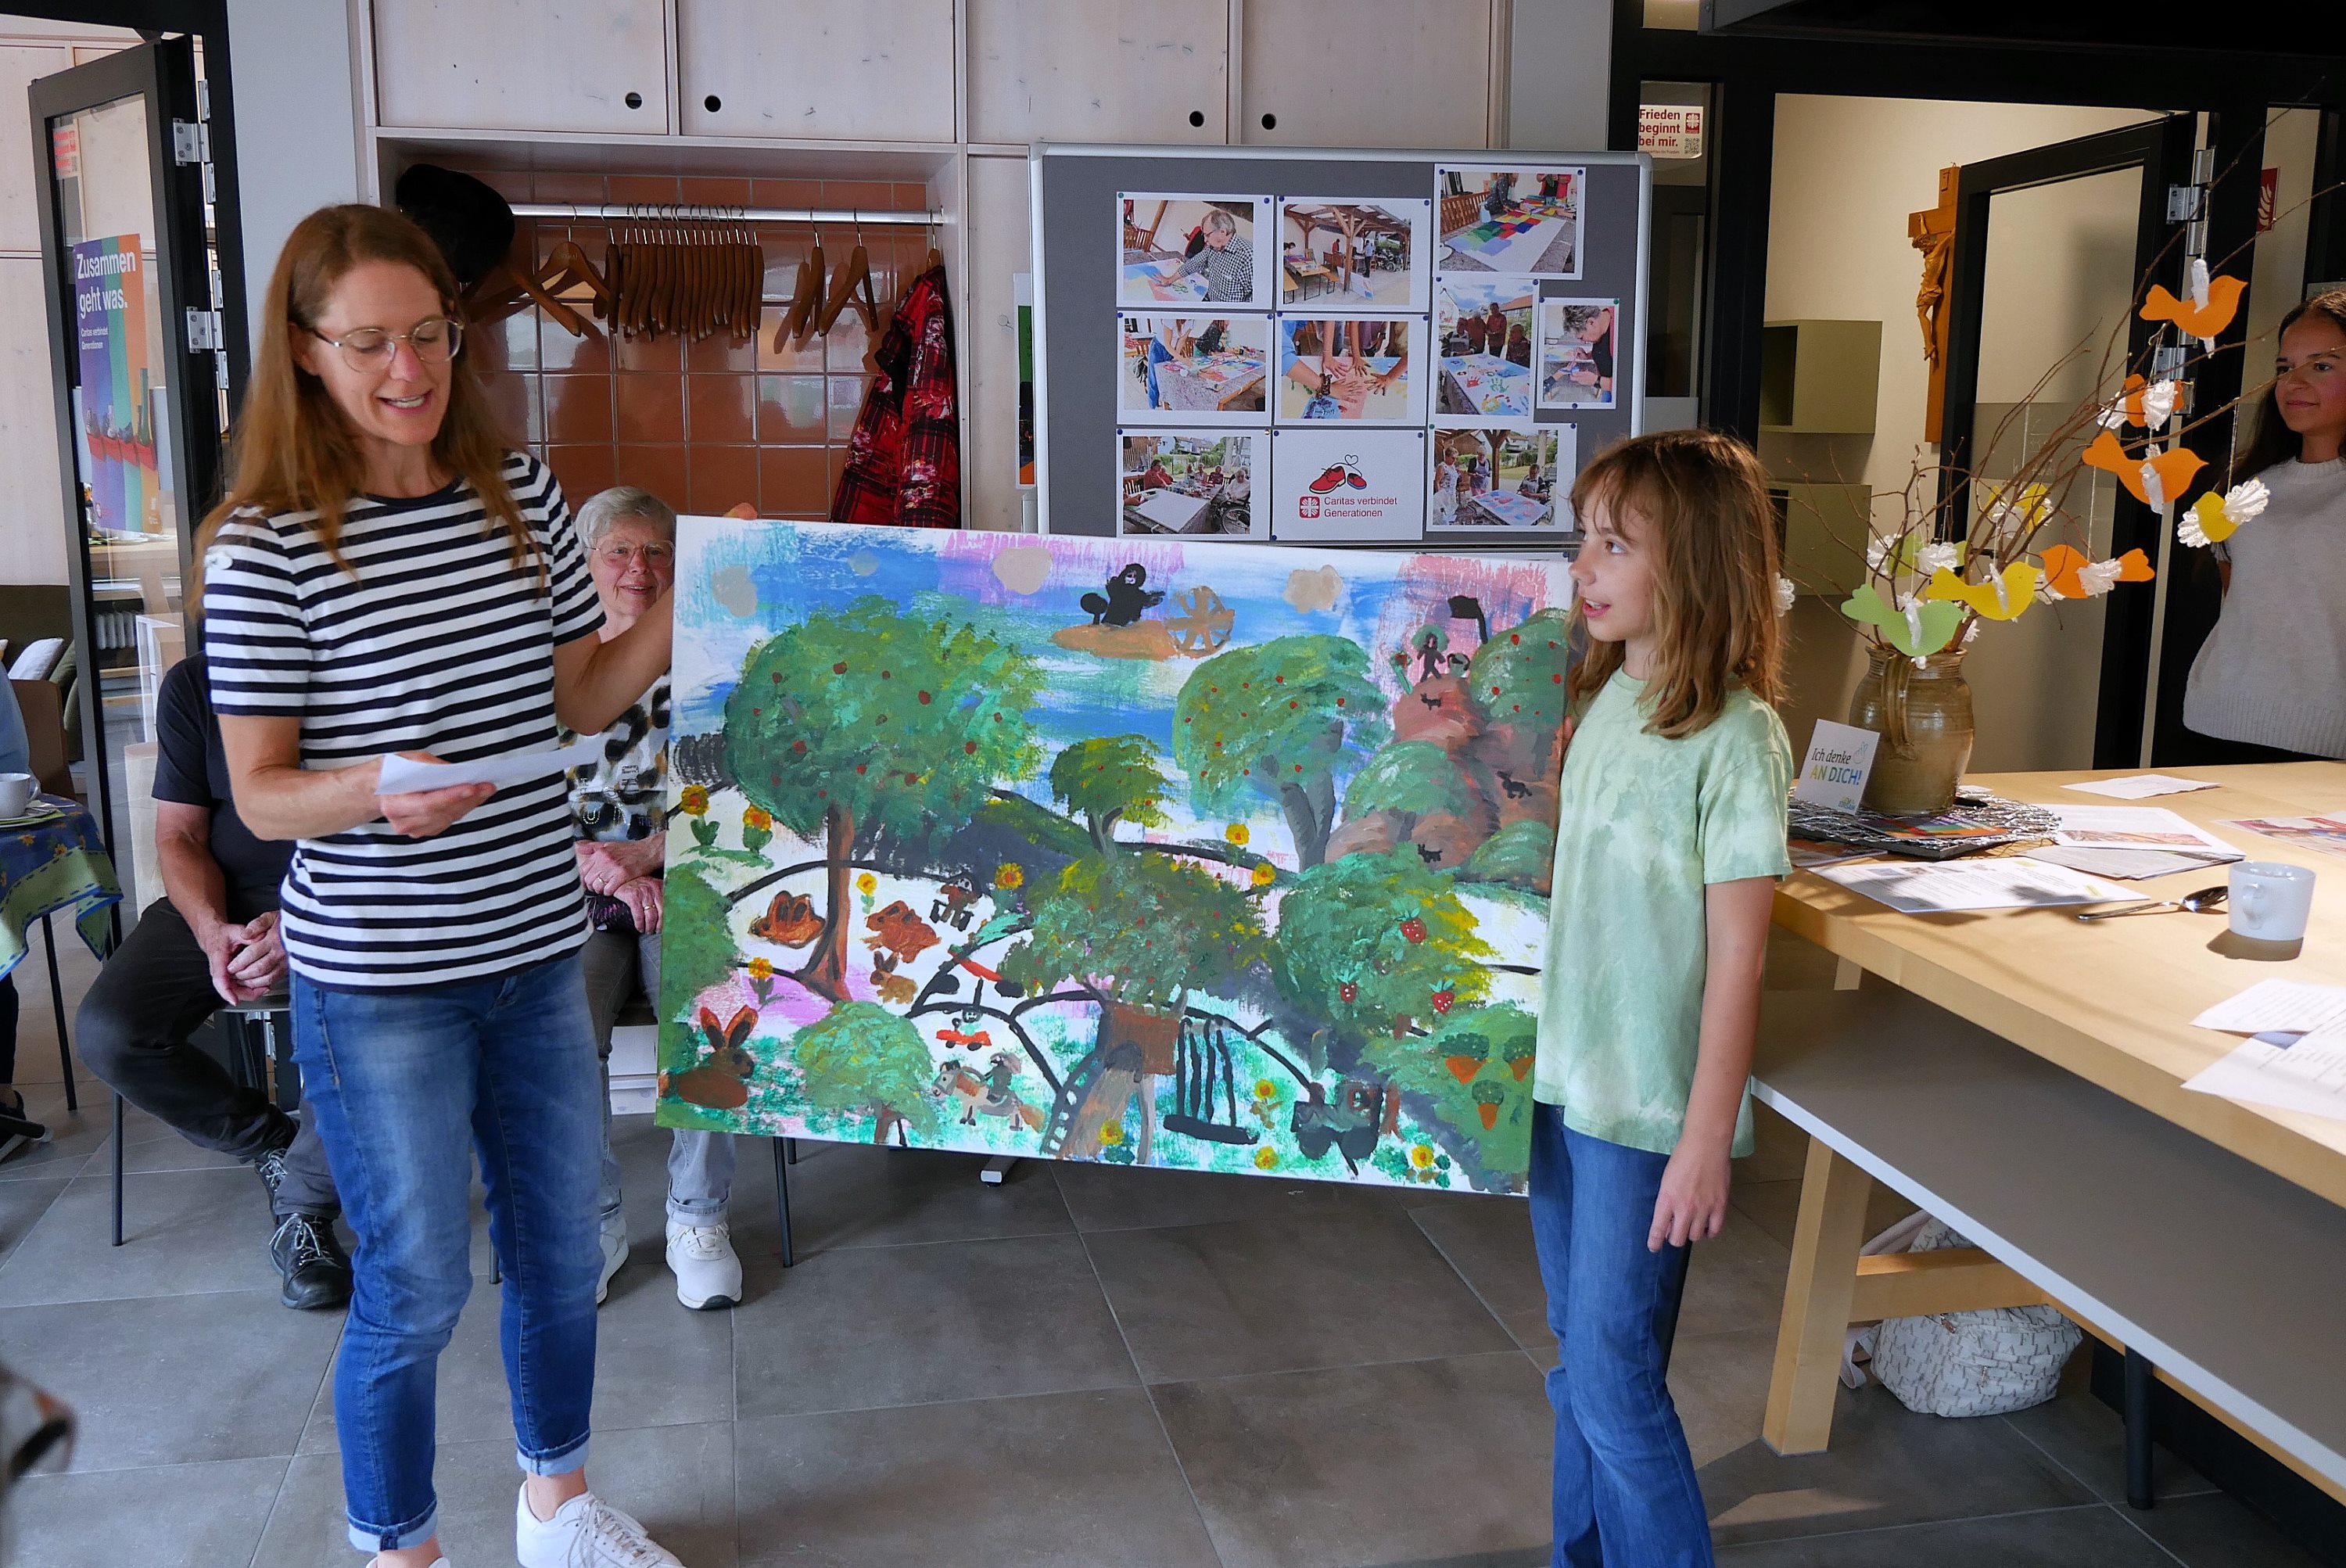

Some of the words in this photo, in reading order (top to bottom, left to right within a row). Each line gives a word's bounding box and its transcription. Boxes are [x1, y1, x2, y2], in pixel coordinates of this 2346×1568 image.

[1639, 109, 1681, 120] Frieden
[1639, 123, 1681, 135] beginnt
[1639, 136, 1655, 146] bei
[1658, 136, 1678, 147] mir.
[77, 251, 136, 279] Zusammen
[80, 286, 102, 319] geht
[102, 288, 128, 310] was.
[1324, 497, 1355, 505] Caritas
[1357, 497, 1397, 505] verbindet
[1811, 748, 1824, 762] Ich
[1825, 749, 1852, 764] denke
[1810, 765, 1828, 780] AN
[1828, 766, 1862, 785] DICH!
